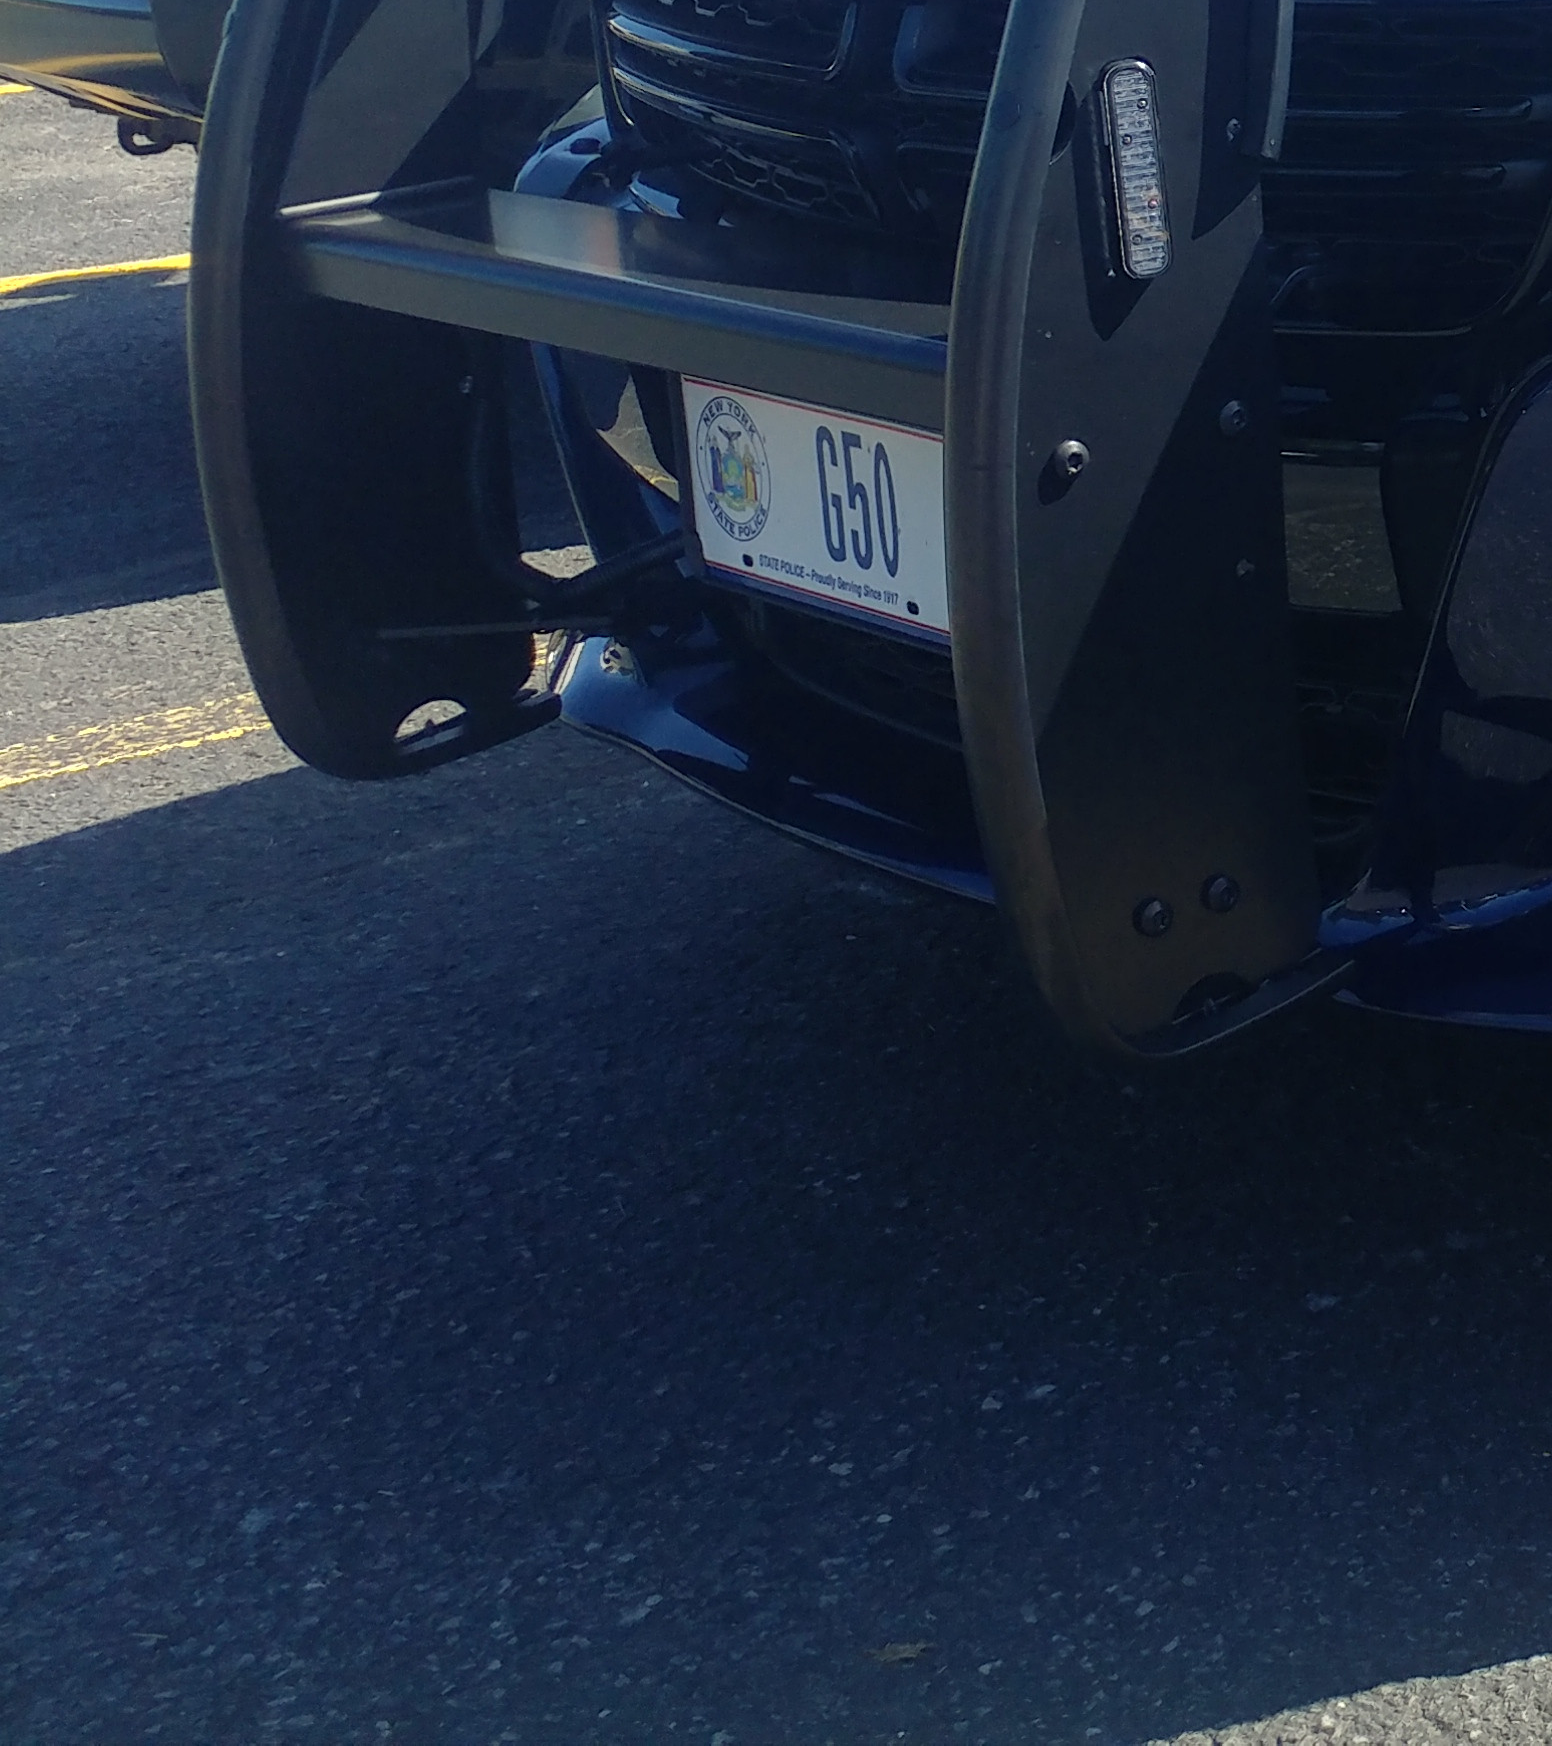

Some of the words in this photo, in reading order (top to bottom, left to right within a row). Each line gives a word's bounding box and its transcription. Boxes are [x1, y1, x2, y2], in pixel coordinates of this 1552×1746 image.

[702, 399, 724, 428] NEW
[726, 401, 756, 439] YORK
[708, 491, 736, 534] STATE
[737, 504, 767, 537] POLICE
[815, 425, 899, 579] G50
[758, 553, 780, 572] STATE
[780, 559, 805, 579] POLICE
[811, 568, 837, 591] Proudly
[837, 576, 862, 599] Serving
[863, 583, 882, 601] Since
[883, 589, 899, 606] 1917
